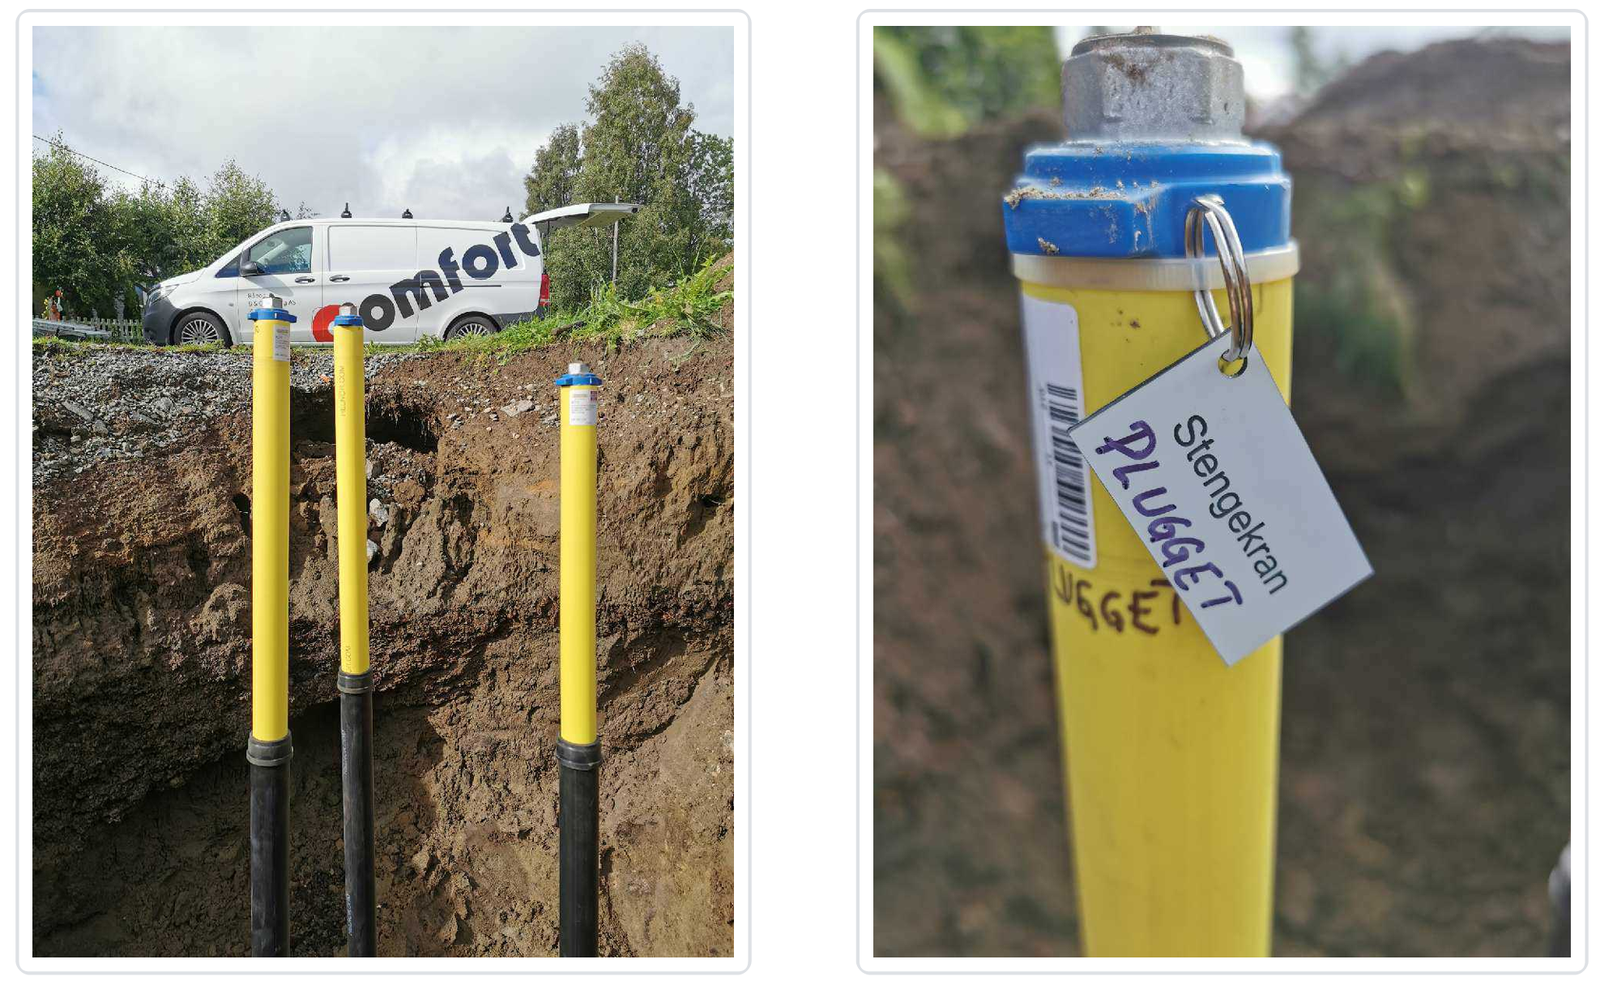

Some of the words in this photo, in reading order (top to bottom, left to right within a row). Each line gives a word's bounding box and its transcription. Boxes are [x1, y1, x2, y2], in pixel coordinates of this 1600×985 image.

[312, 223, 541, 343] comfort
[1095, 420, 1244, 609] PLUGGET
[1173, 414, 1288, 595] Stengekran
[1055, 564, 1181, 636] UGGET
